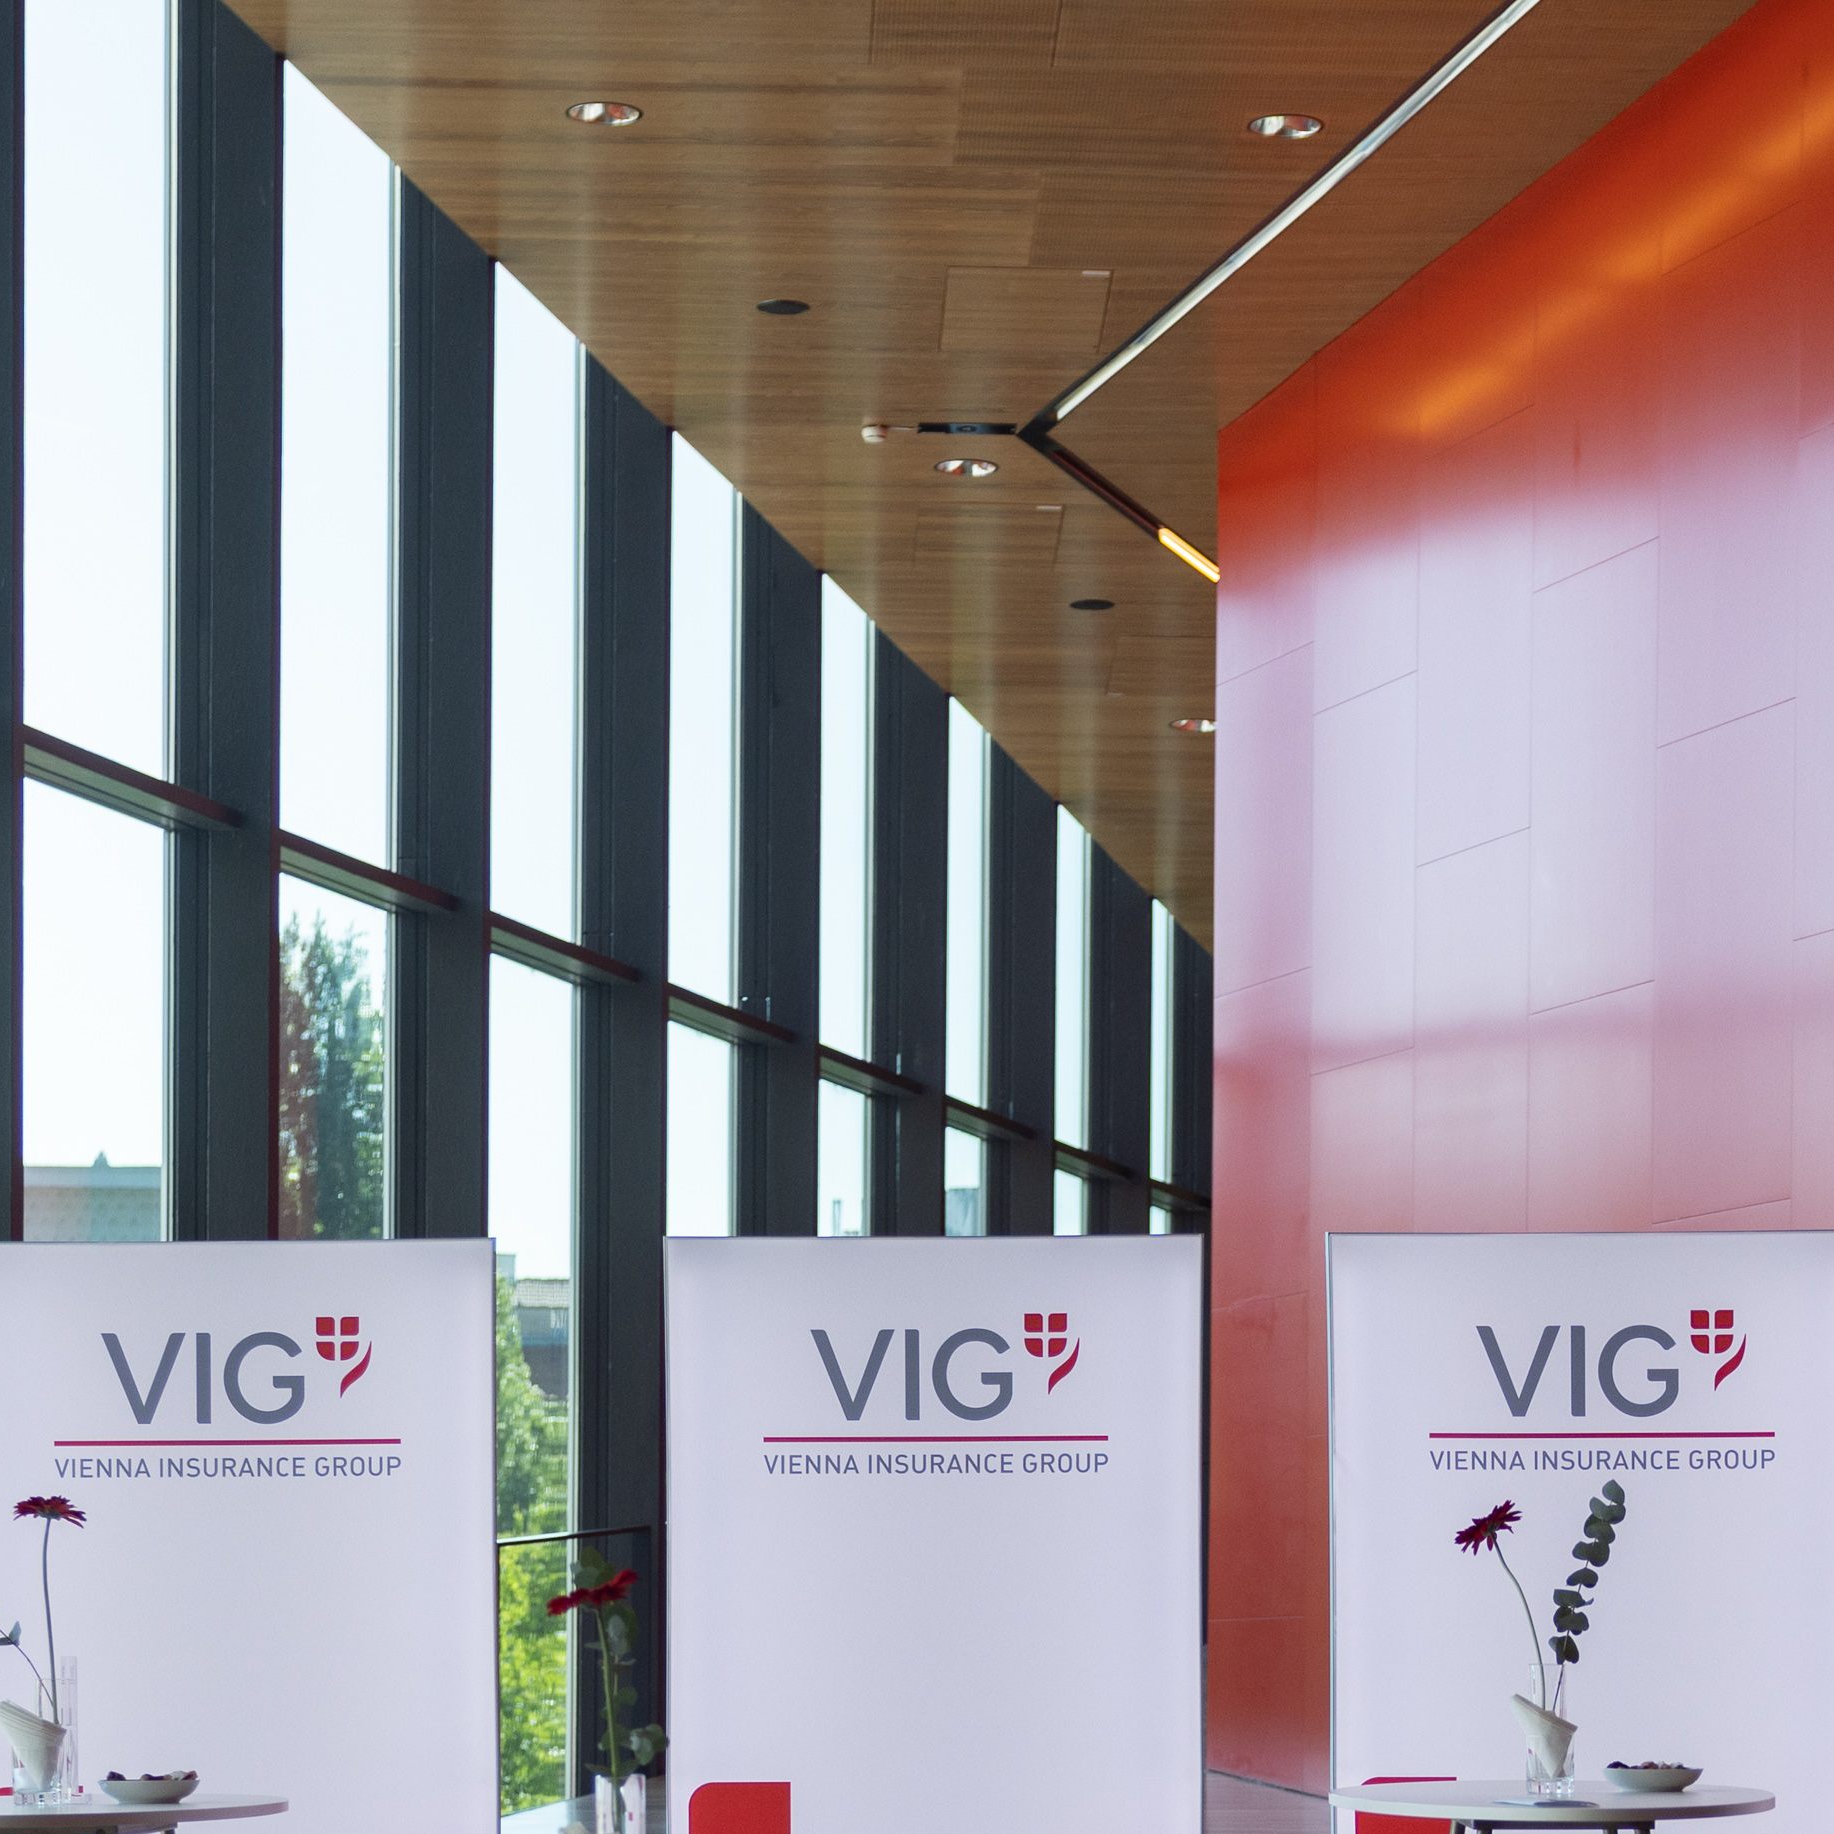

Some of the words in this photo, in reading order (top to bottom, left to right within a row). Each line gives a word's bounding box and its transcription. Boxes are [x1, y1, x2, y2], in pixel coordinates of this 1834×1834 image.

[101, 1332, 304, 1424] VIG
[811, 1328, 1012, 1421] VIG
[1476, 1325, 1679, 1417] VIG
[54, 1458, 150, 1478] VIENNA
[159, 1457, 306, 1478] INSURANCE
[315, 1457, 401, 1477] GROUP
[764, 1455, 859, 1474] VIENNA
[868, 1454, 1014, 1474] INSURANCE
[1023, 1453, 1109, 1473] GROUP
[1429, 1451, 1525, 1470] VIENNA
[1534, 1450, 1680, 1470] INSURANCE
[1689, 1449, 1775, 1469] GROUP
